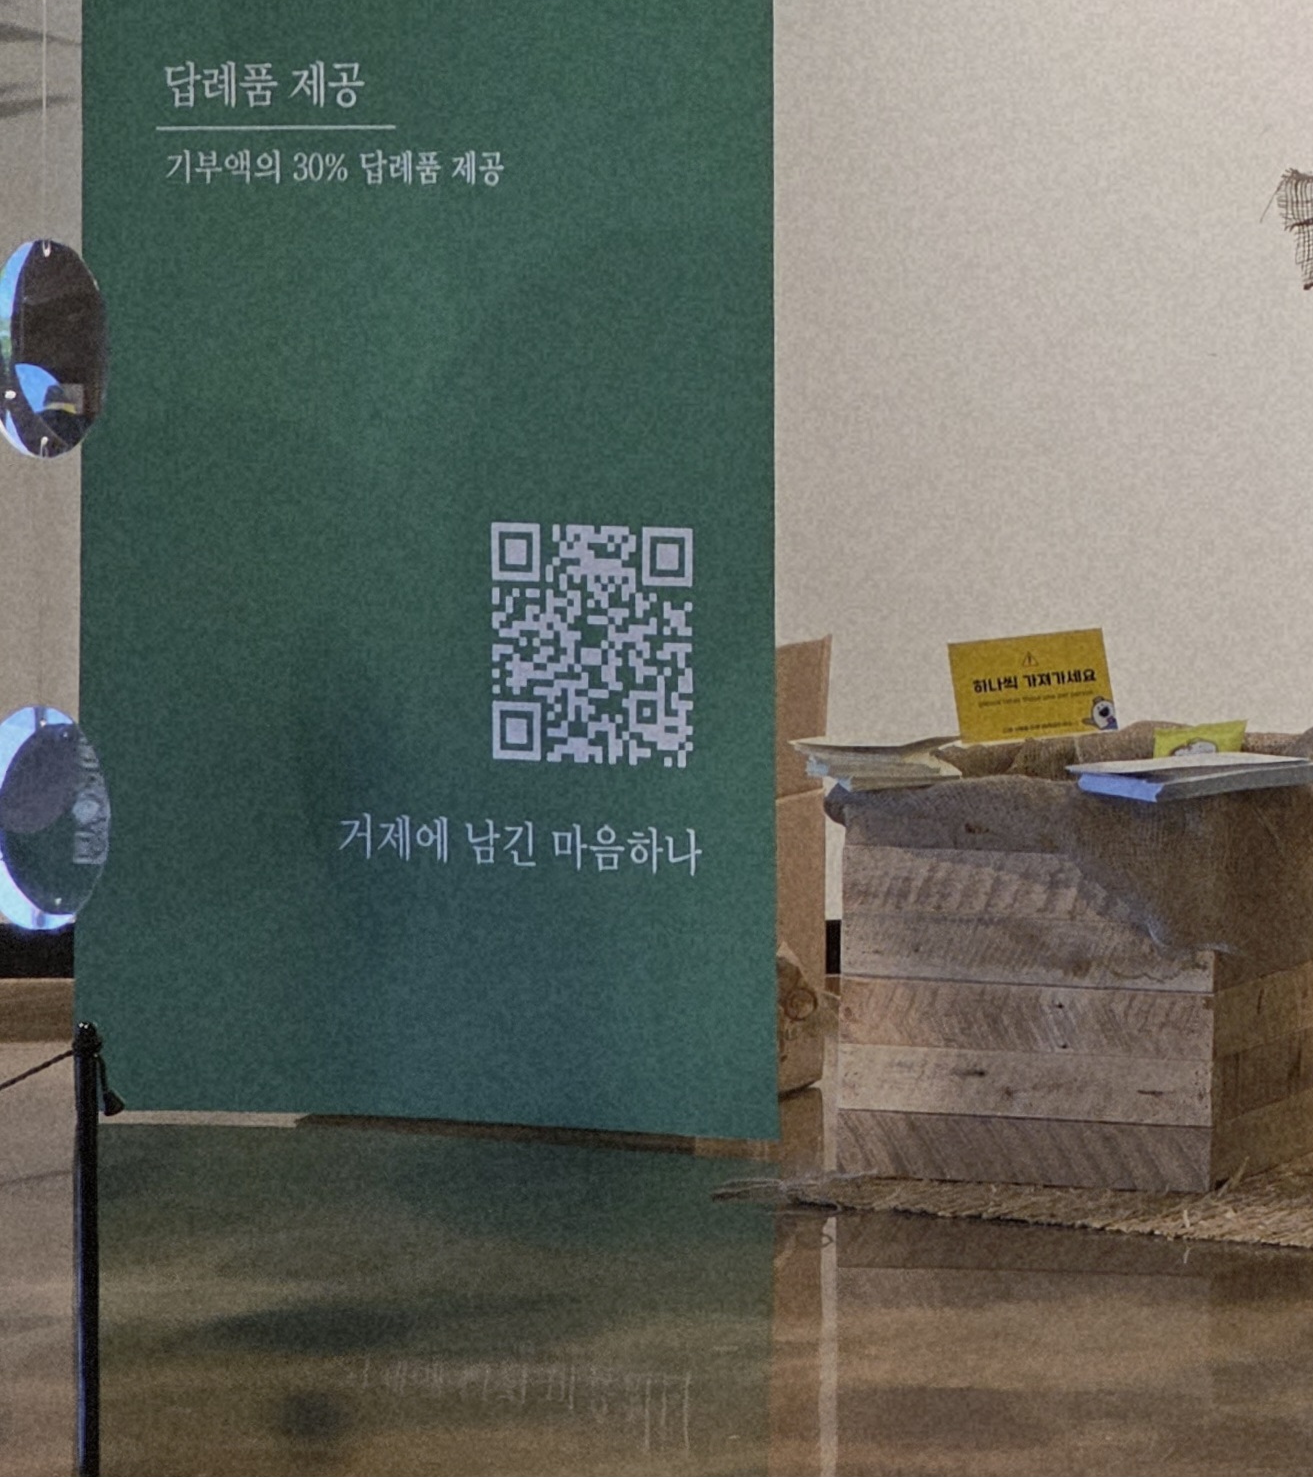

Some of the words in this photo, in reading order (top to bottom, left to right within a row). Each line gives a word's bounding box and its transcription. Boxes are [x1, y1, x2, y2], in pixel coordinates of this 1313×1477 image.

[163, 59, 279, 109] 답례품
[290, 59, 366, 109] 제공
[166, 148, 282, 185] 기부액의
[291, 151, 350, 183] 30%
[359, 148, 443, 186] 답례품
[451, 149, 506, 188] 제공
[972, 675, 1019, 694] 하나씩
[1023, 669, 1097, 689] 가져가세요
[339, 811, 450, 864] 거제에
[464, 817, 537, 868] 남긴
[551, 822, 704, 878] 마음하나
